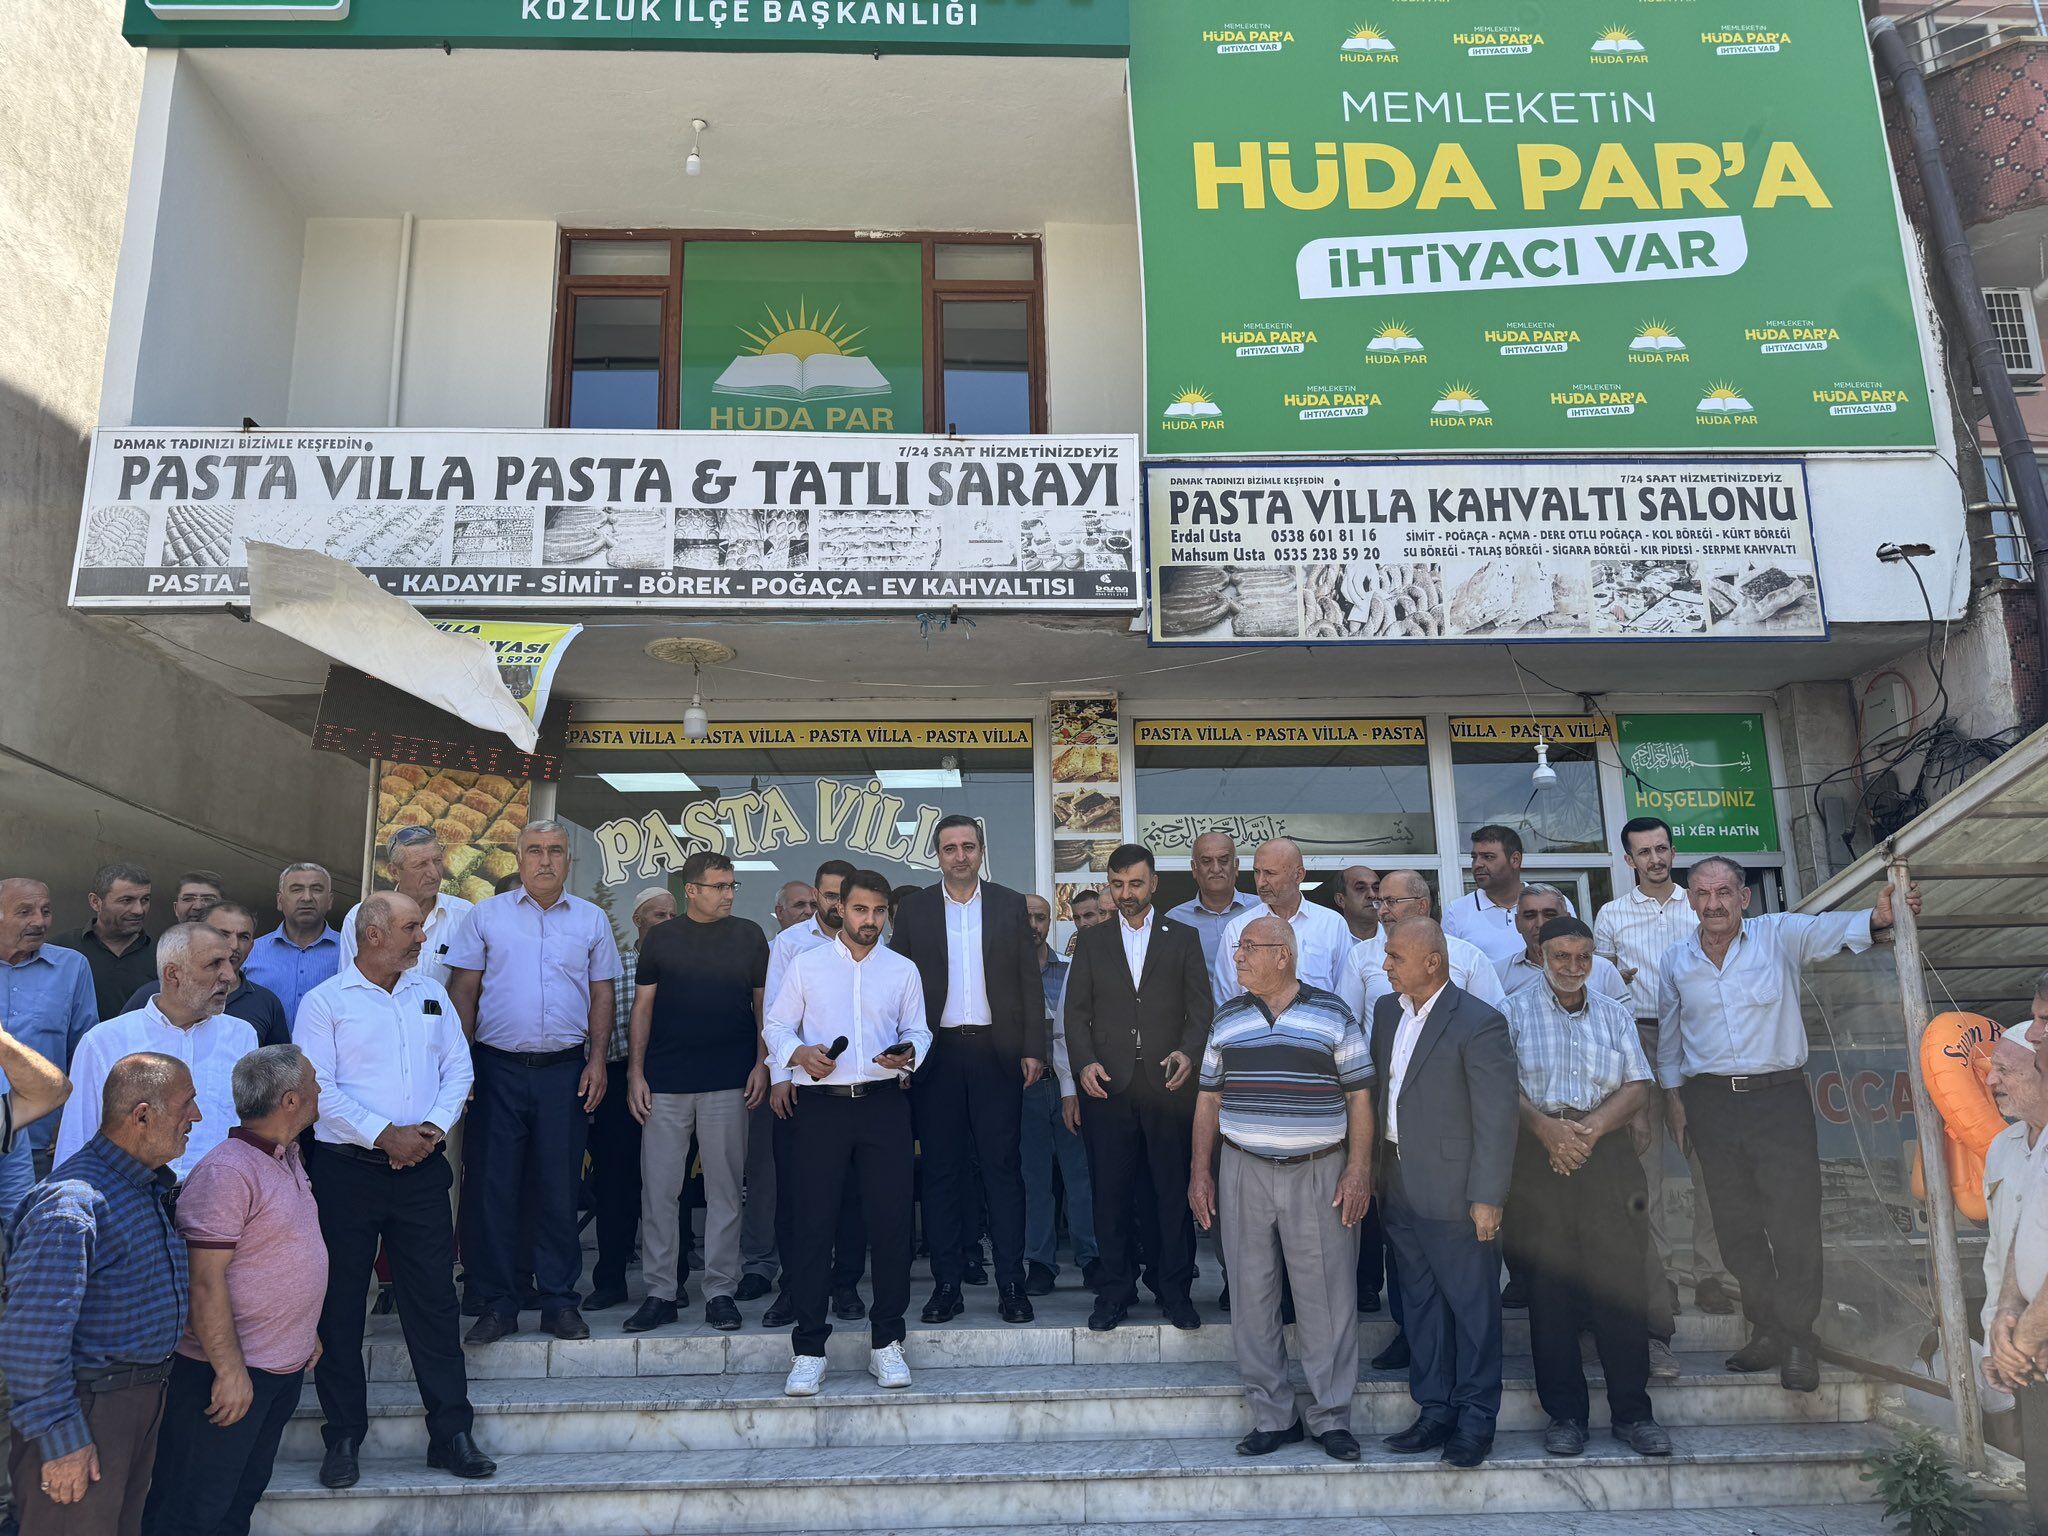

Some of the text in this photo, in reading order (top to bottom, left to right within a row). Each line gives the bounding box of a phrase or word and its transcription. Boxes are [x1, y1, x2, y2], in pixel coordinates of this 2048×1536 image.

[764, 0, 977, 29] BAŞKANLIĞI
[1377, 54, 1398, 62] PAR
[1627, 55, 1648, 63] PAR
[1343, 91, 1656, 124] MEMLEKETİN
[1193, 141, 1833, 210] HÜDA PAR'A
[1329, 230, 1719, 288] İHTİYACI VAR
[1545, 344, 1563, 352] VAR
[1404, 355, 1427, 363] PAR
[1667, 354, 1689, 362] PAR
[1345, 408, 1364, 416] VAR
[1612, 406, 1630, 414] VAR
[711, 407, 895, 430] HÜDA PAR
[1201, 421, 1224, 429] PAR
[1469, 417, 1493, 426] PAR
[1735, 415, 1757, 424] PAR
[114, 436, 362, 452] DAMAK TADINIZI BİZİMLE KEŞFEDİN
[899, 444, 1118, 458] 7/24 SAAT HİZMETİNİZDEYİZ
[118, 441, 1119, 506] PASTA VİLLA PASTA & TATLI SARAYI
[1170, 475, 1324, 487] DAMAK TADINIZI BİZİMLE KEŞFEDİN
[1621, 473, 1782, 483] 7/24 SAAT HİZMETİNİZDEYİZ
[1170, 478, 1798, 525] PASTA VİLLA KAHVALTI SALONU
[1171, 529, 1376, 543] Erdal Usta 0538 601 81 16
[1406, 527, 1790, 544] SİMİT POĞAÇA AÇMA DERE OTLU POĞAÇA KOL BÖREĞİ KÜRT BÖREĞİ
[1172, 547, 1380, 562] Mahsum Usta 0535 238 59 20
[1404, 543, 1796, 558] SU BÖREĞİ TALAŞ BÖREĞİ SİGARA BÖREĞİ KIR PİDESİ SERPME KAHVALTI
[148, 574, 234, 592] PASTA
[402, 574, 522, 593] KADAYIF
[541, 570, 619, 593] SİMİT
[639, 572, 731, 595] BÖREK
[752, 573, 862, 599] POĞAÇA
[883, 578, 918, 595] EV
[922, 578, 1075, 596] KAHVALTISI
[569, 730, 624, 744] PASTA
[629, 728, 676, 744] VİLLA
[749, 728, 795, 743] VİLLA
[809, 730, 862, 743] PASTA
[864, 726, 913, 743] VİLLA
[926, 730, 979, 744] PASTA
[982, 727, 1029, 743] VİLLA
[1141, 725, 1424, 741] PASTA VİLLA PASTA VİLLA PASTA
[1450, 722, 1610, 738] VİLLA PASTA VİLLA
[1636, 787, 1756, 811] HOŞGELDİNİZ
[595, 777, 991, 886] PASTA VİLL
